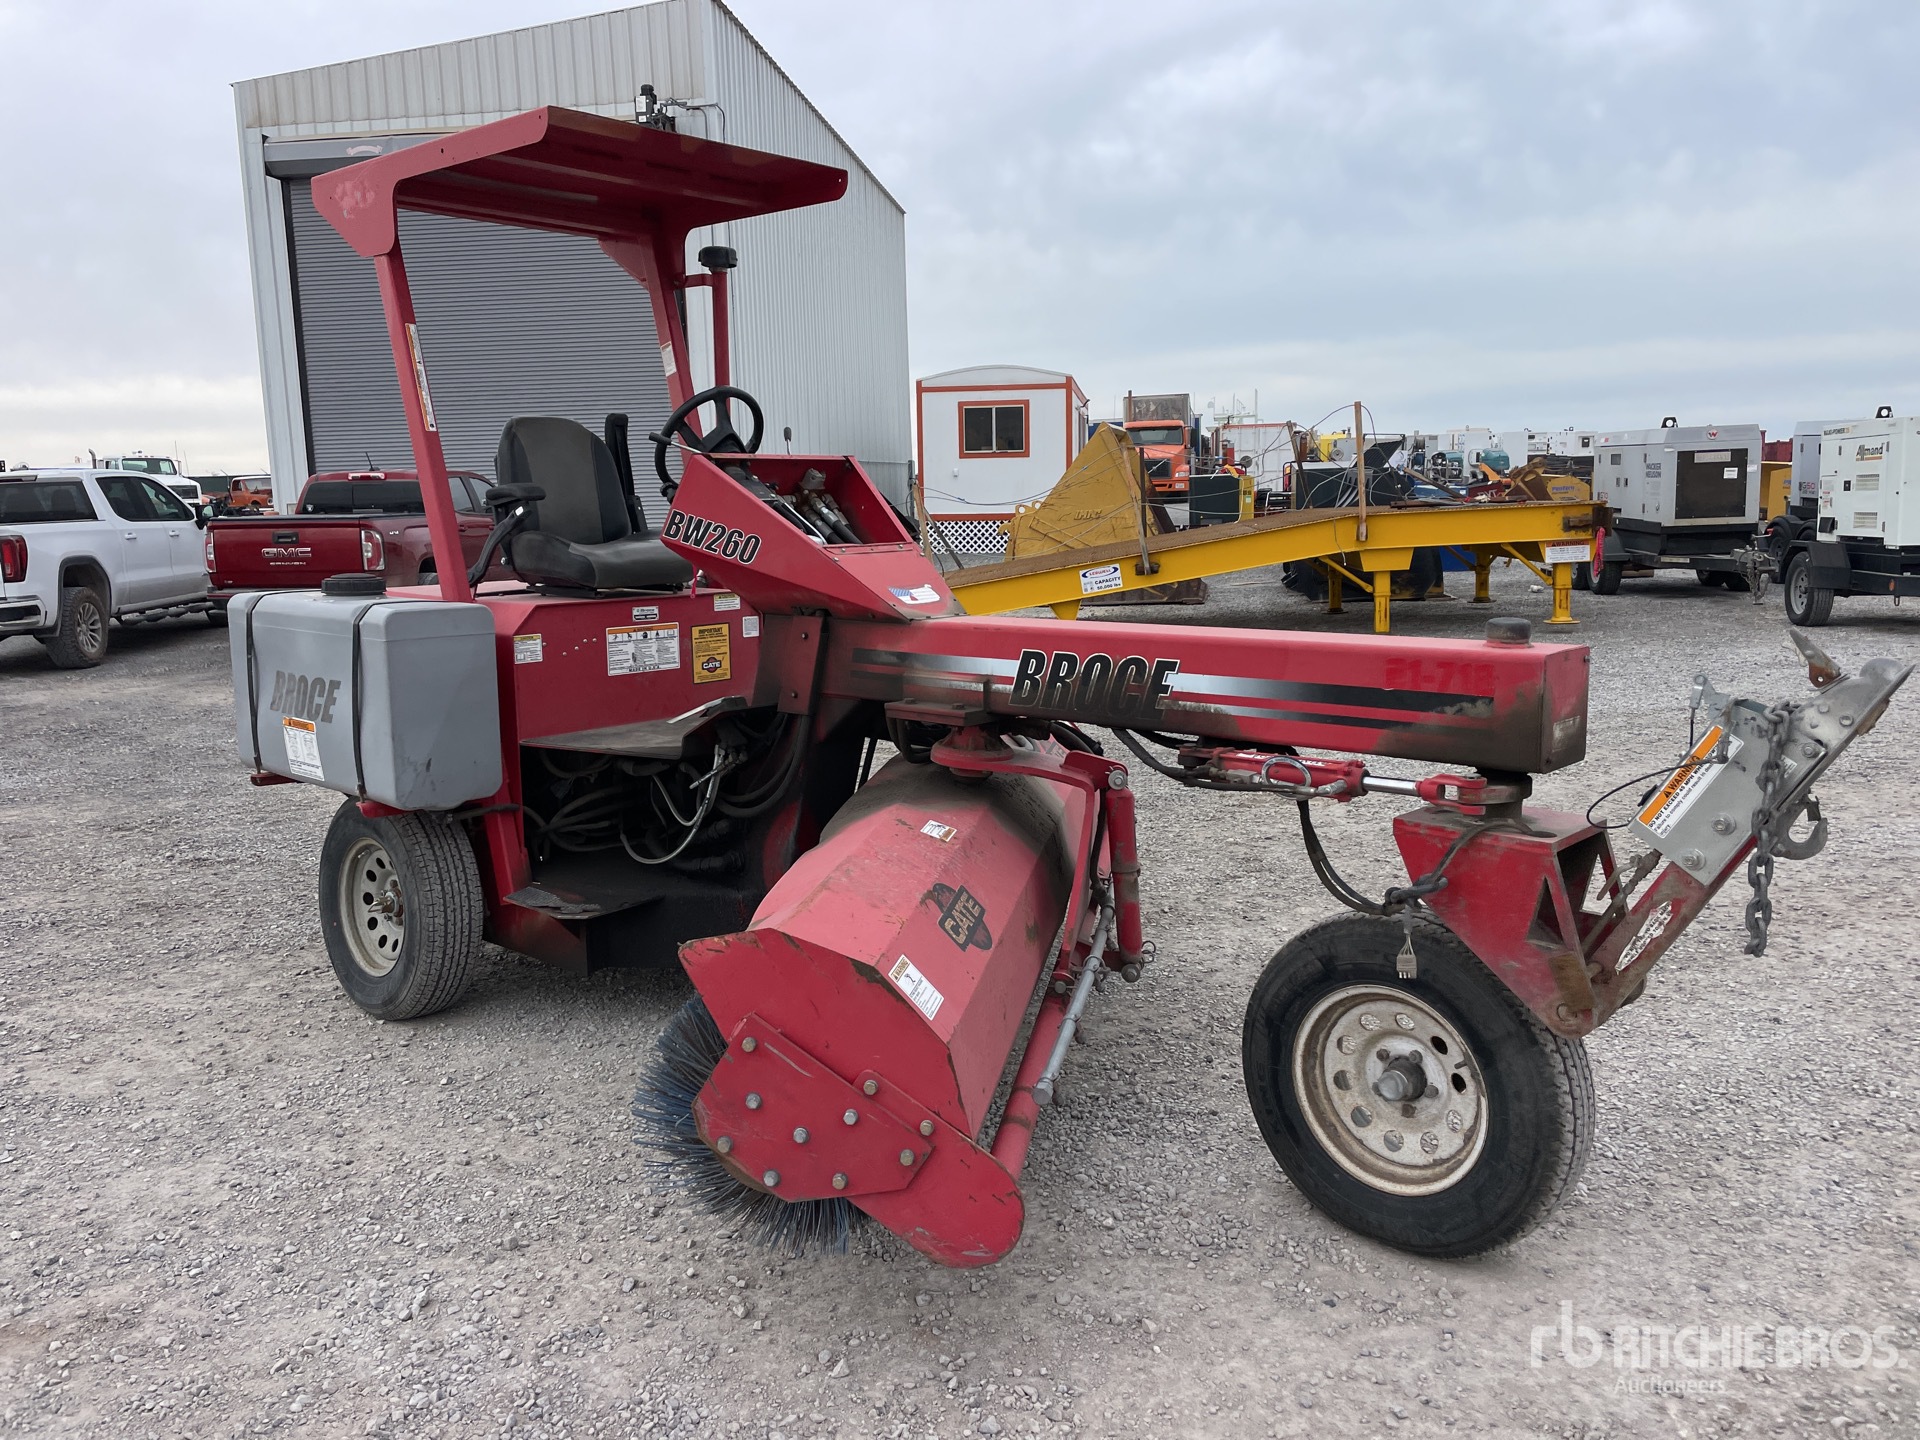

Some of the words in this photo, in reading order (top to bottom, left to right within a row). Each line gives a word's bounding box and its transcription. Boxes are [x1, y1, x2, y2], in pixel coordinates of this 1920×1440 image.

[1856, 444, 1883, 459] Allmand
[662, 508, 762, 565] BW260
[261, 547, 312, 558] GMC
[1094, 576, 1121, 585] CAPACITY
[698, 627, 723, 635] IMPORTANT
[703, 661, 721, 669] CATE
[269, 669, 342, 724] BROCE
[1007, 648, 1181, 721] BROCE
[1655, 809, 1664, 820] NOT
[1663, 791, 1680, 810] EXCEED
[1684, 774, 1695, 786] MPH
[943, 890, 983, 945] CATE
